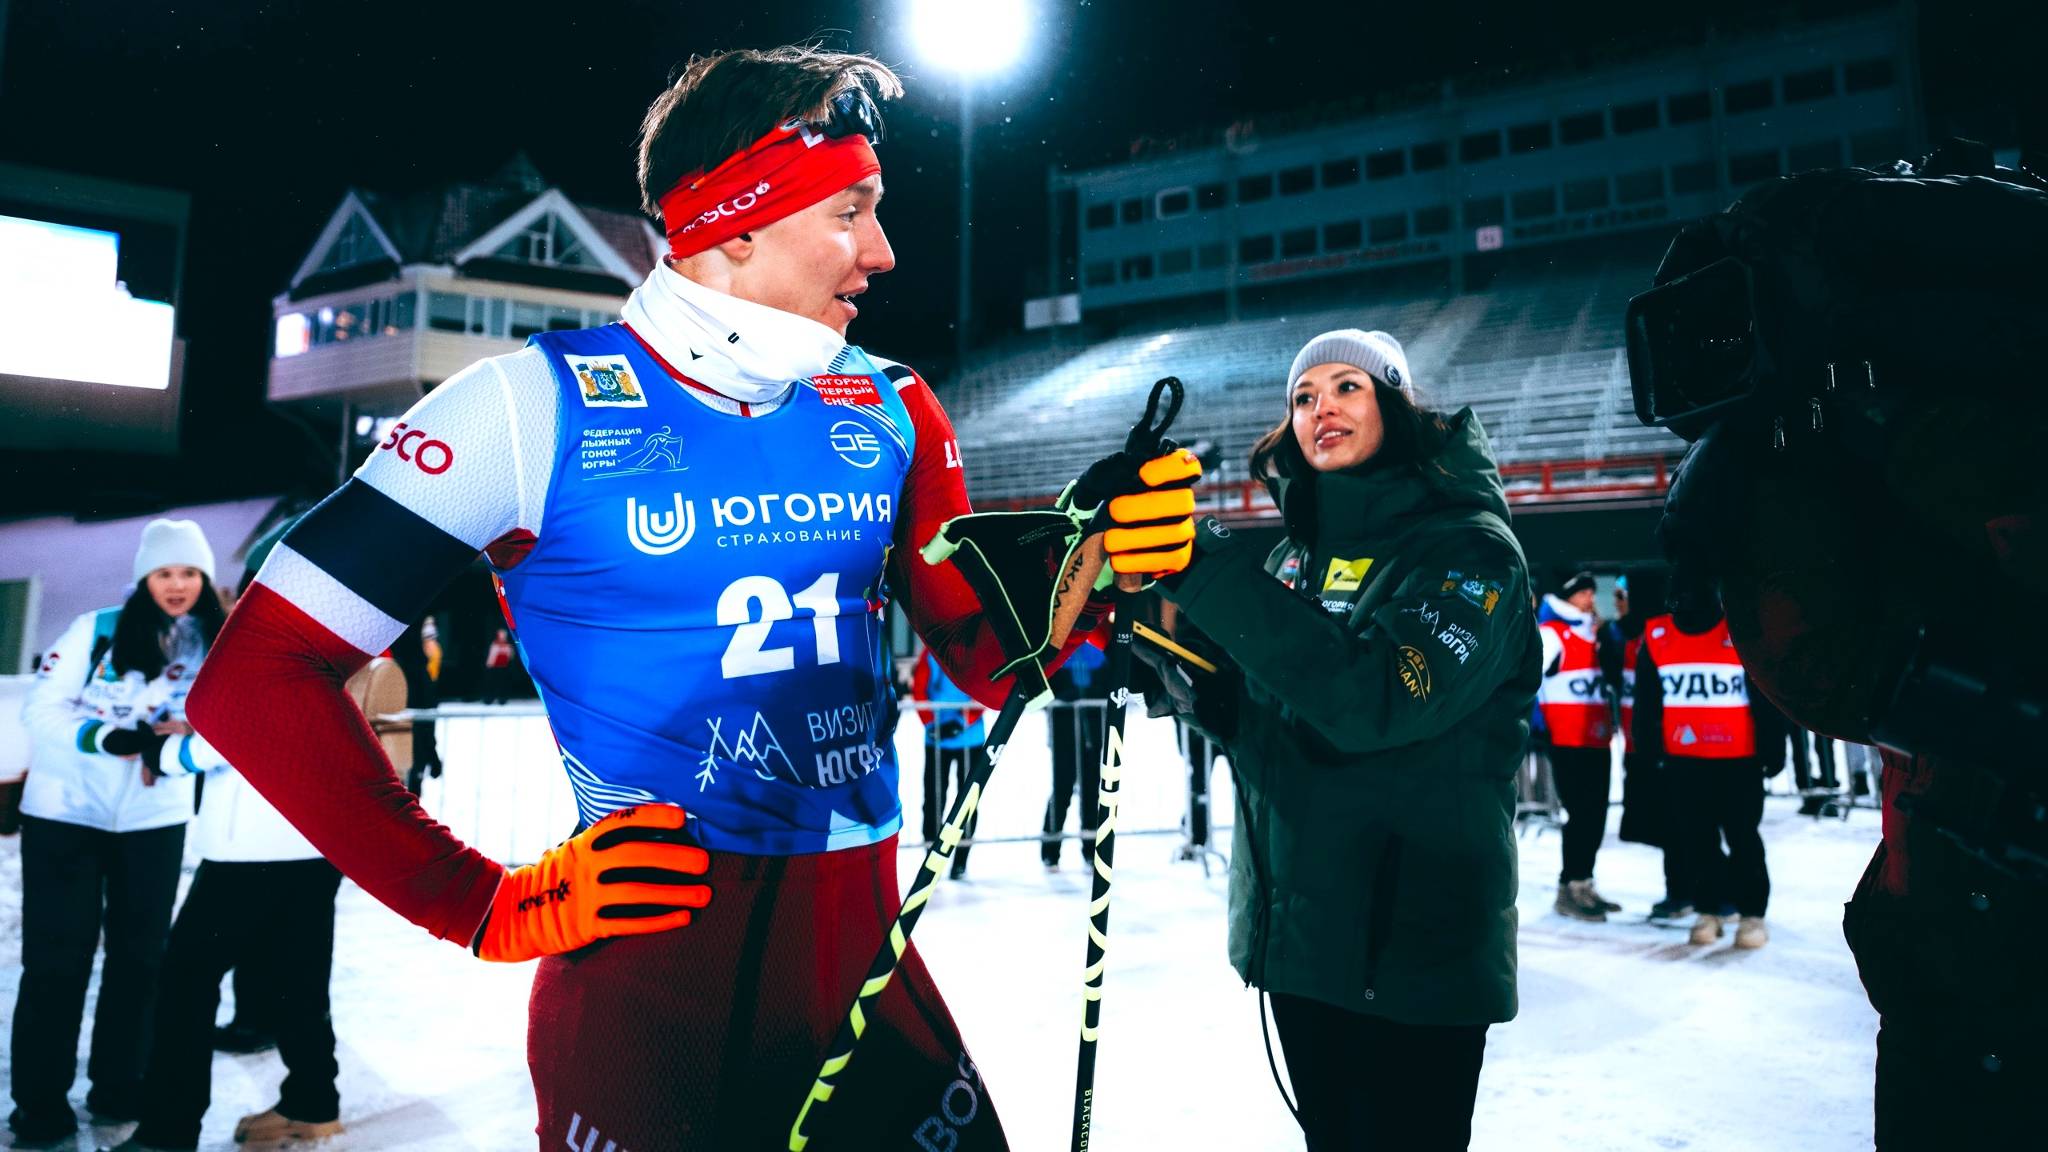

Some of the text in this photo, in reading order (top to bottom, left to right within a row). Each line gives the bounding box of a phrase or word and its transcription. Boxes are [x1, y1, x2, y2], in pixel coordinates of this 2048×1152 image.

[818, 386, 875, 395] ПЕРВЫЙ
[823, 397, 856, 406] СНЕГ
[582, 427, 643, 437] ФЕДЕРАЦИЯ
[581, 438, 632, 448] ЛЫЖНЫХ
[581, 449, 618, 459] ГОНОК
[582, 460, 616, 470] ЮГРЫ
[711, 492, 892, 528] ЮГОРИЯ
[716, 529, 862, 548] СТРАХОВАНИЕ
[716, 572, 841, 680] 21
[1447, 622, 1479, 652] ВИЗИТ
[1437, 630, 1470, 665] ЮГРА
[806, 701, 876, 743] ВИЗИТ
